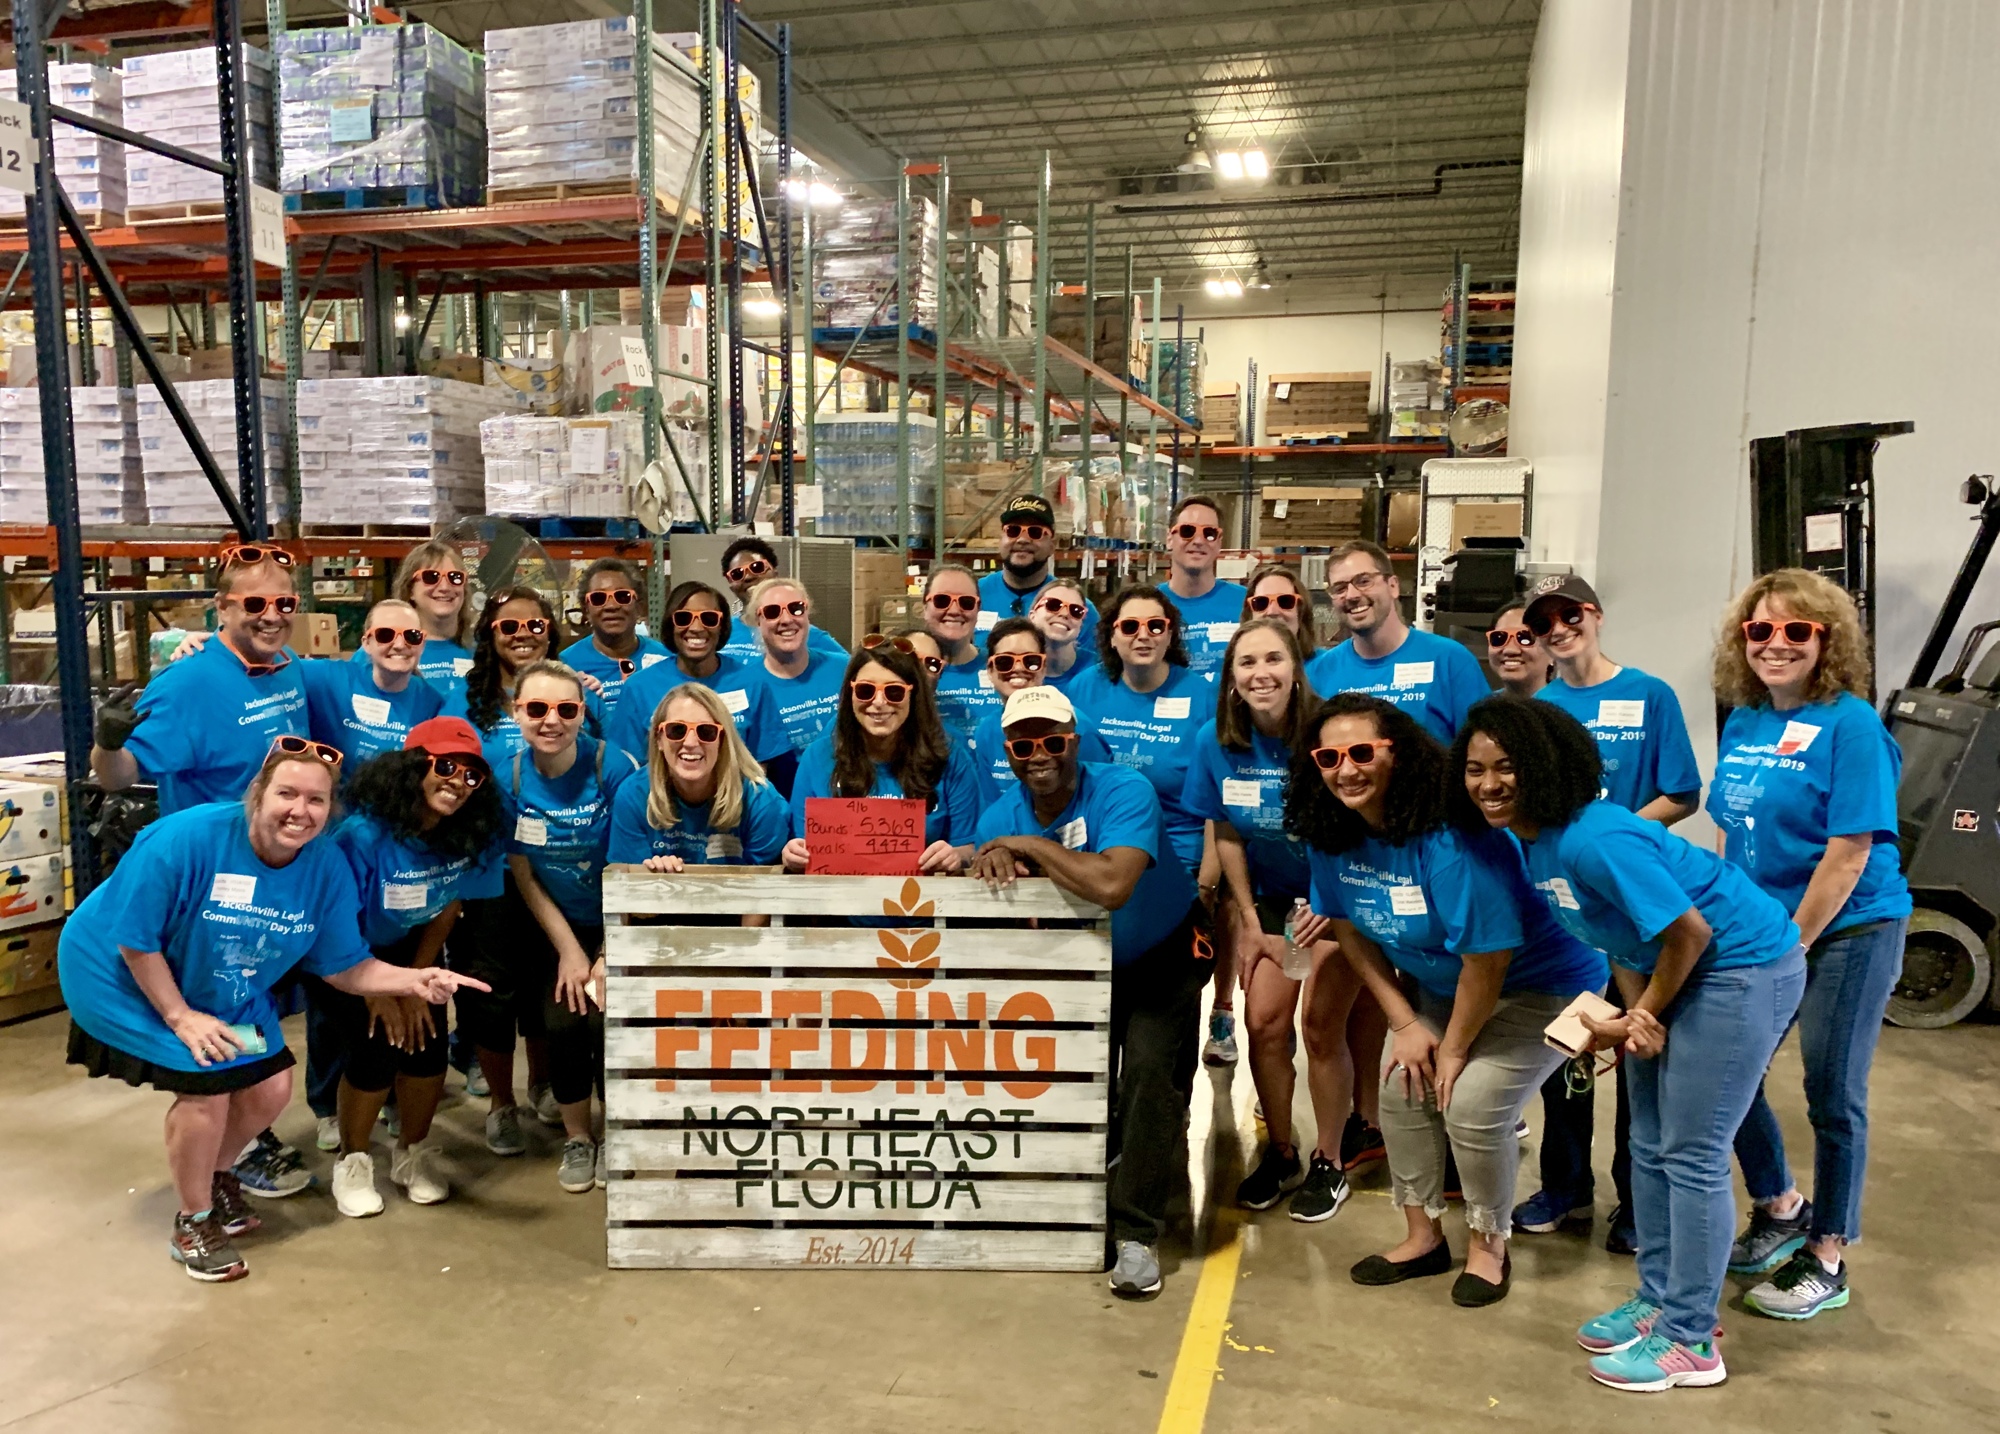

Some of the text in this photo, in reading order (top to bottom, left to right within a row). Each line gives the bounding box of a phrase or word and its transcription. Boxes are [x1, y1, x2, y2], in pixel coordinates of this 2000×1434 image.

[254, 196, 278, 217] Rack
[261, 228, 275, 251] 11
[625, 344, 643, 355] Rack
[633, 364, 645, 377] 10
[417, 661, 454, 670] ksonville
[974, 688, 995, 696] Legal
[1402, 692, 1426, 702] 2019
[779, 692, 840, 715] cksonville Legal
[968, 697, 985, 706] Day
[816, 706, 832, 715] Day
[1100, 716, 1172, 733] Jacksonville Legal
[1140, 732, 1157, 743] Day
[1158, 734, 1180, 744] 2019
[1596, 731, 1646, 743] Day 2019
[573, 816, 592, 827] Day
[1392, 873, 1413, 887] Legal
[218, 899, 305, 924] Jacksonville Legal
[202, 909, 316, 936] CommUNITY Day 2019
[655, 989, 1057, 1099] FEEDING
[682, 1105, 1035, 1161] NORTHEAST
[735, 1157, 982, 1210] FLORIDA
[801, 1236, 917, 1265] Est. 2014
